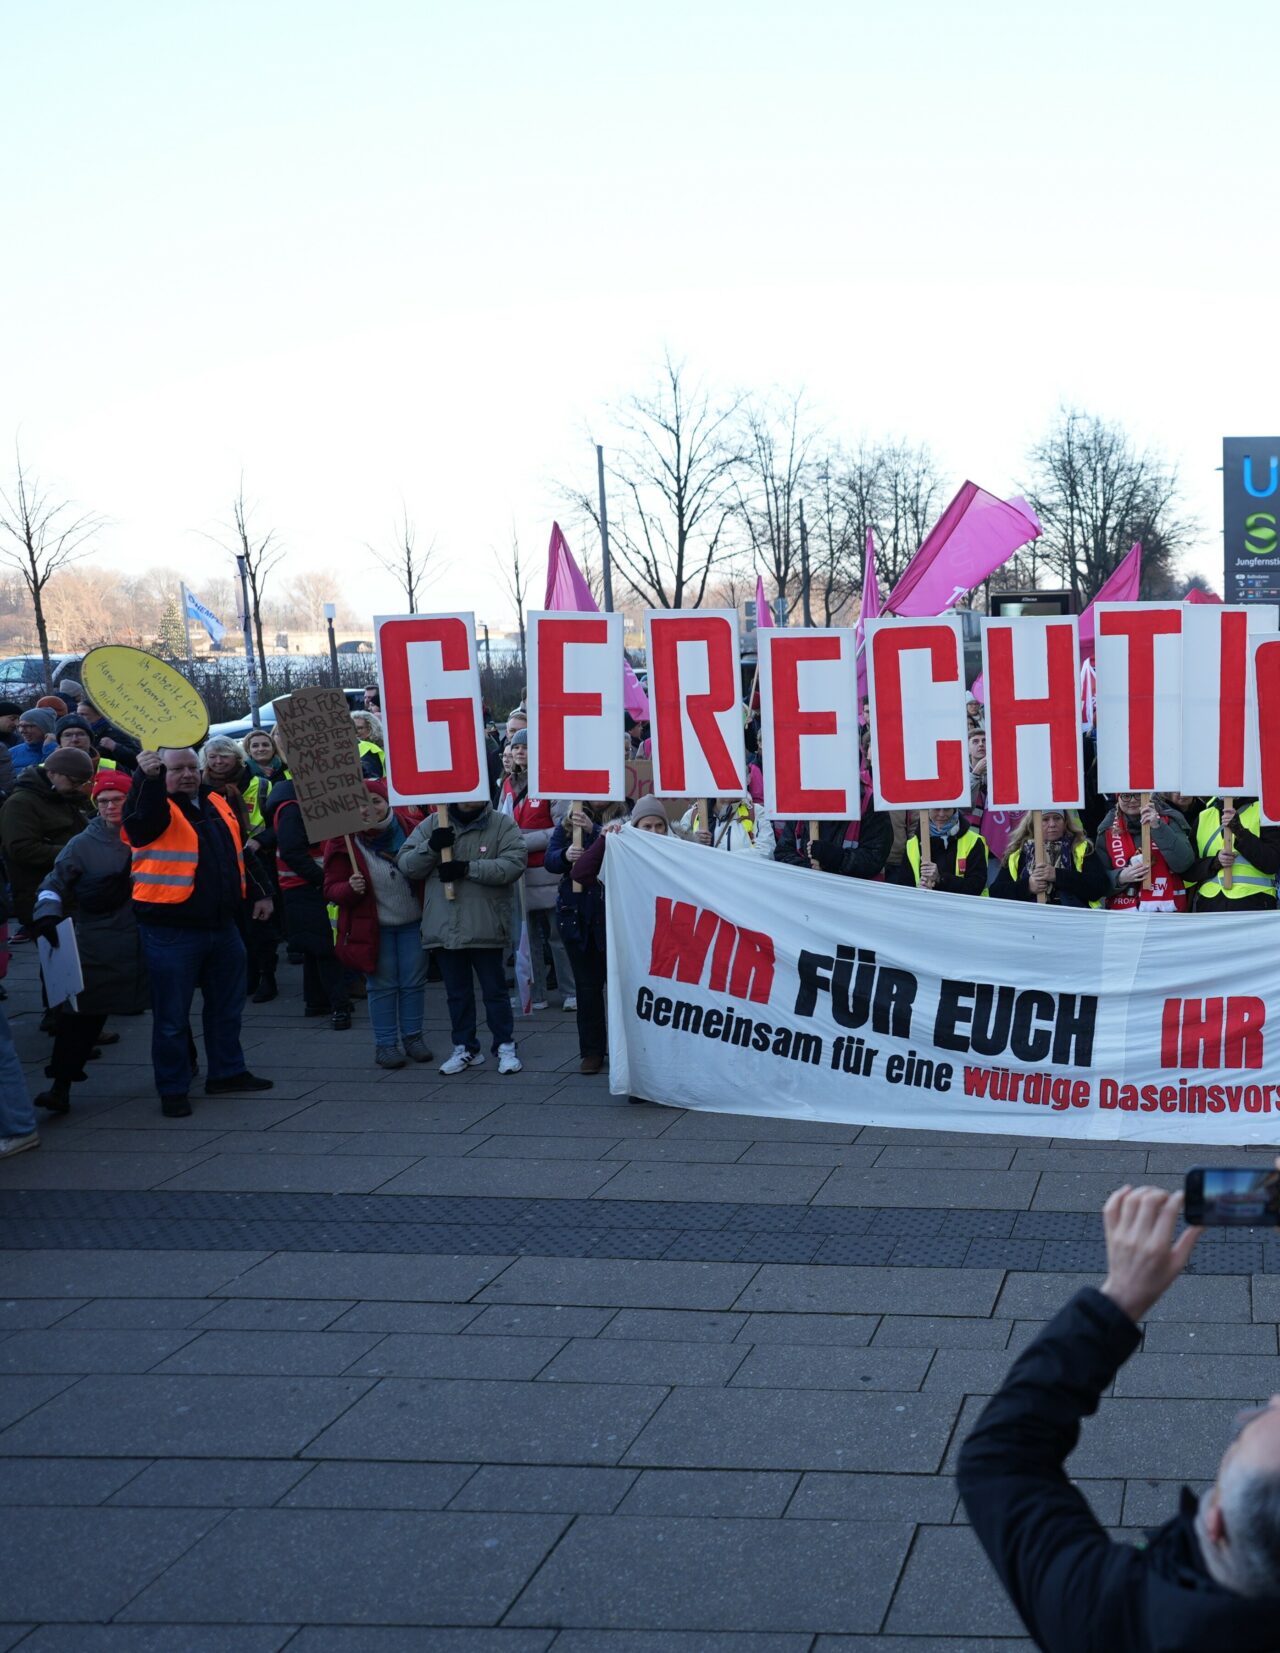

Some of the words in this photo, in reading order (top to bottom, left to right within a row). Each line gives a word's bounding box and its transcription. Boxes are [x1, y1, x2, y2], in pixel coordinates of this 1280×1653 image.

[1243, 456, 1279, 498] U
[277, 697, 313, 722] WER
[315, 692, 345, 713] FÜR
[280, 711, 350, 738] HAMBURG
[287, 727, 353, 753] ARBEITET
[292, 752, 355, 780] HAMBURG
[296, 768, 362, 801] LEISTEN
[303, 788, 371, 822] KÖNNEN
[648, 896, 776, 1005] WIR
[794, 944, 918, 1039] FÜR
[933, 979, 1099, 1067] EUCH
[1160, 995, 1266, 1069] IHR
[635, 985, 822, 1066] Gemeinsam
[831, 1035, 879, 1078] für
[885, 1050, 953, 1092] eine
[963, 1066, 1090, 1111] würdige
